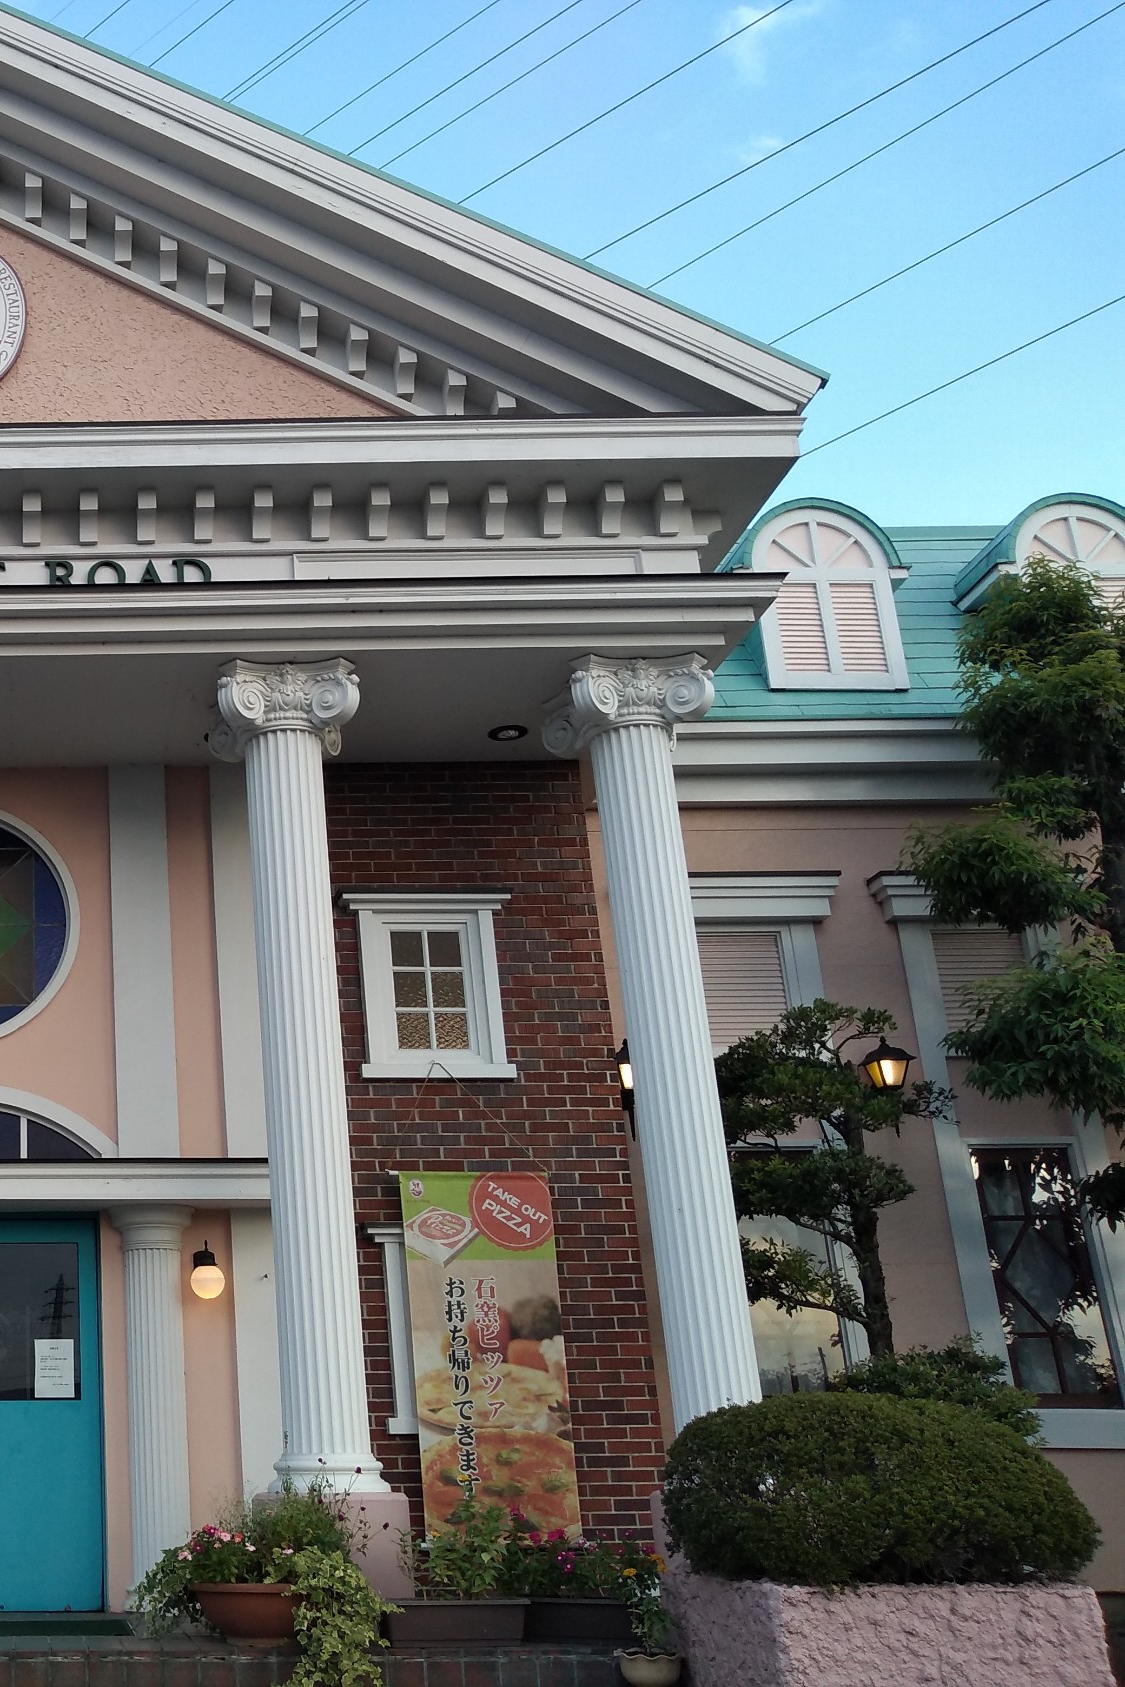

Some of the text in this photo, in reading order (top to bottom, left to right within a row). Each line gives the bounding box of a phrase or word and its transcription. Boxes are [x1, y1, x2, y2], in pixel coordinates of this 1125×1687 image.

[44, 559, 213, 586] ROAD
[481, 1199, 532, 1240] PIZZA
[486, 1181, 549, 1225] TAKE OUT
[472, 1276, 507, 1422] 石窯ピッツァ
